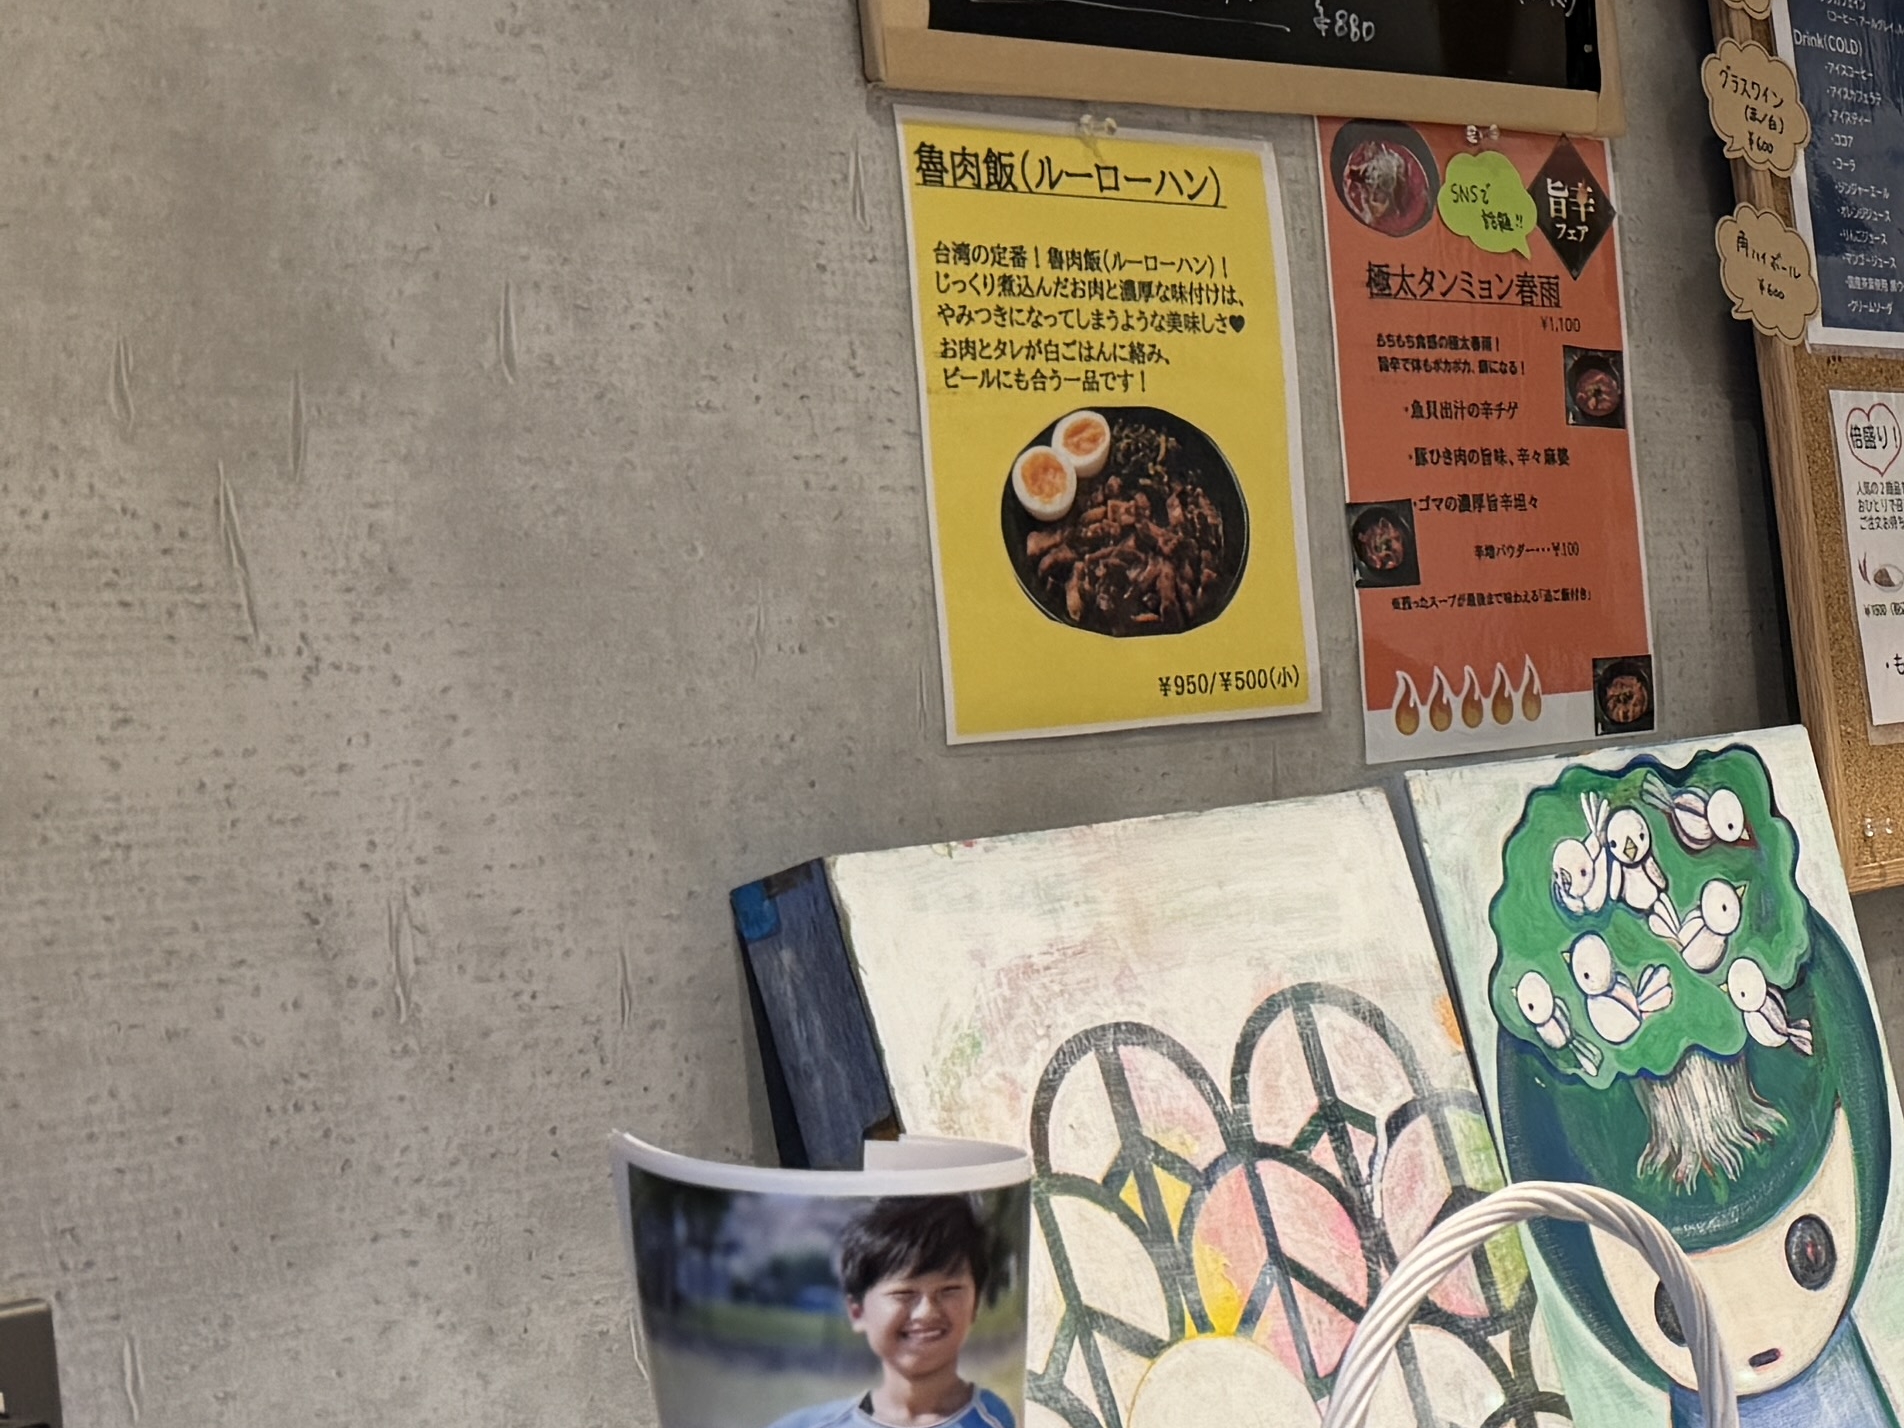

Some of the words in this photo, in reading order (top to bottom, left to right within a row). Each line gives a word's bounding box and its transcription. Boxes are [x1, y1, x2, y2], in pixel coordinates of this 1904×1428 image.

[1794, 28, 1863, 56] Drink(COLD)
[1718, 66, 1784, 107] グラスワイン
[914, 141, 1221, 207] 魯肉飯(ルーローハン)
[1451, 182, 1491, 205] SNSで
[1556, 224, 1589, 242] フェア
[1736, 230, 1801, 280] 角ハイボール
[1366, 261, 1561, 308] 極太タンミョン春雨
